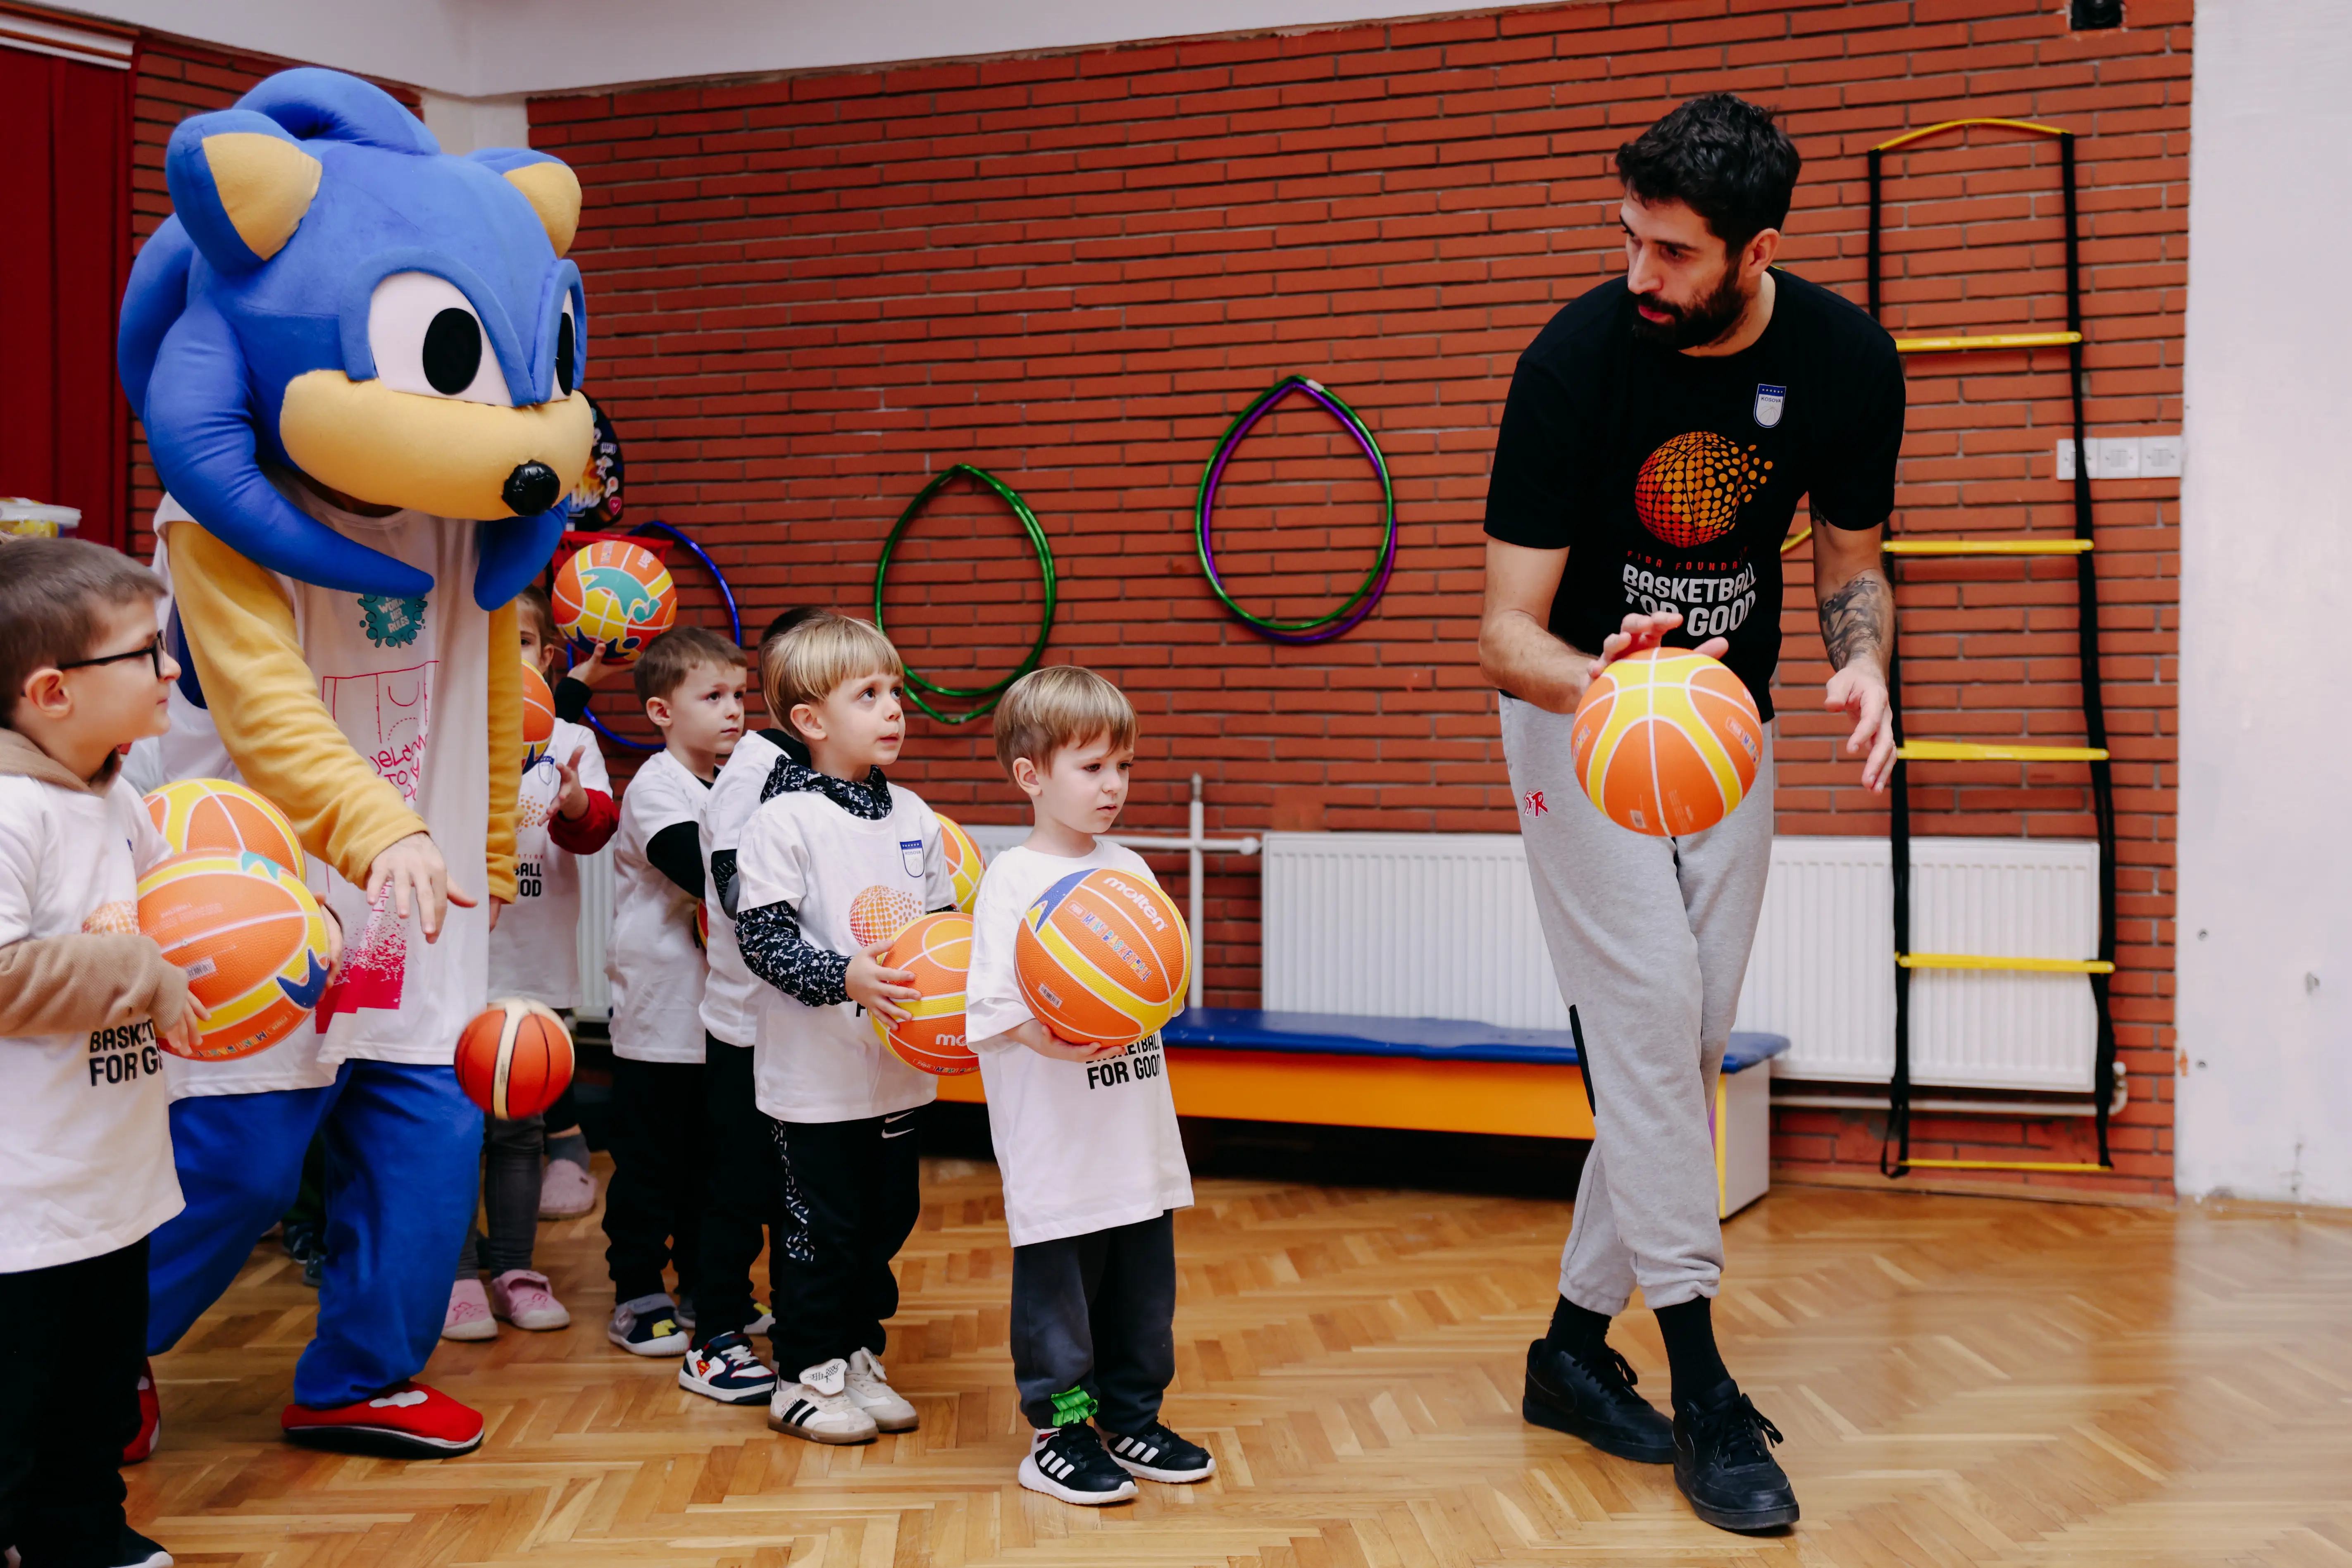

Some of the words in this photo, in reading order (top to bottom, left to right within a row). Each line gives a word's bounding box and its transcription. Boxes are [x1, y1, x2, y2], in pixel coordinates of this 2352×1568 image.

[1628, 550, 1662, 568] FIBA
[1623, 562, 1756, 603] BASKETBALL
[1102, 877, 1165, 932] molten
[89, 1052, 138, 1087] FOR
[1087, 1061, 1130, 1090] FOR
